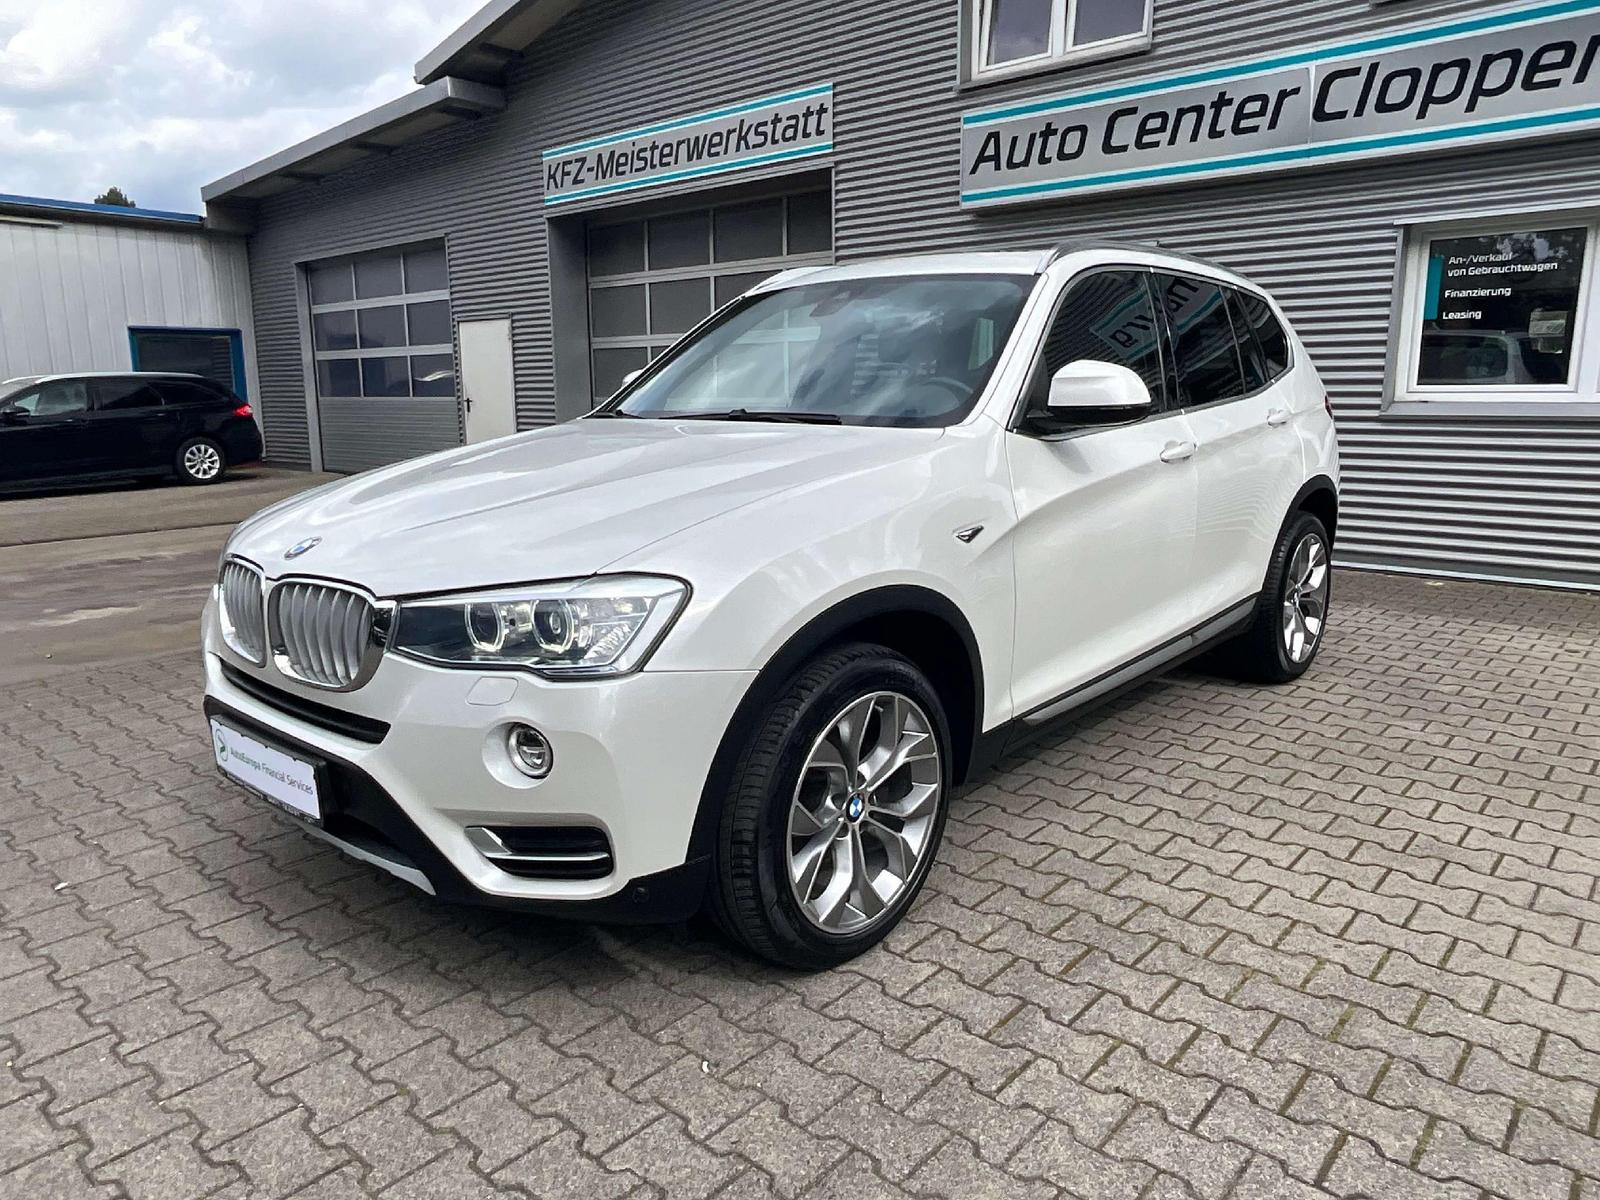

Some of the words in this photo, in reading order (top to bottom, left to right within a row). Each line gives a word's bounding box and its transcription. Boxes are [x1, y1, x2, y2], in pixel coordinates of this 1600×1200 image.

[969, 121, 1087, 175] Auto
[1101, 86, 1300, 154] Center
[546, 102, 828, 190] KFZ-Meisterwerkstatt
[1449, 252, 1513, 265] An-/Verkauf
[1448, 267, 1466, 277] von
[1468, 262, 1558, 276] Gebrauchtwagen
[1444, 287, 1512, 298] Finanzierung
[1442, 309, 1482, 320] Leasing
[286, 774, 314, 795] Services
